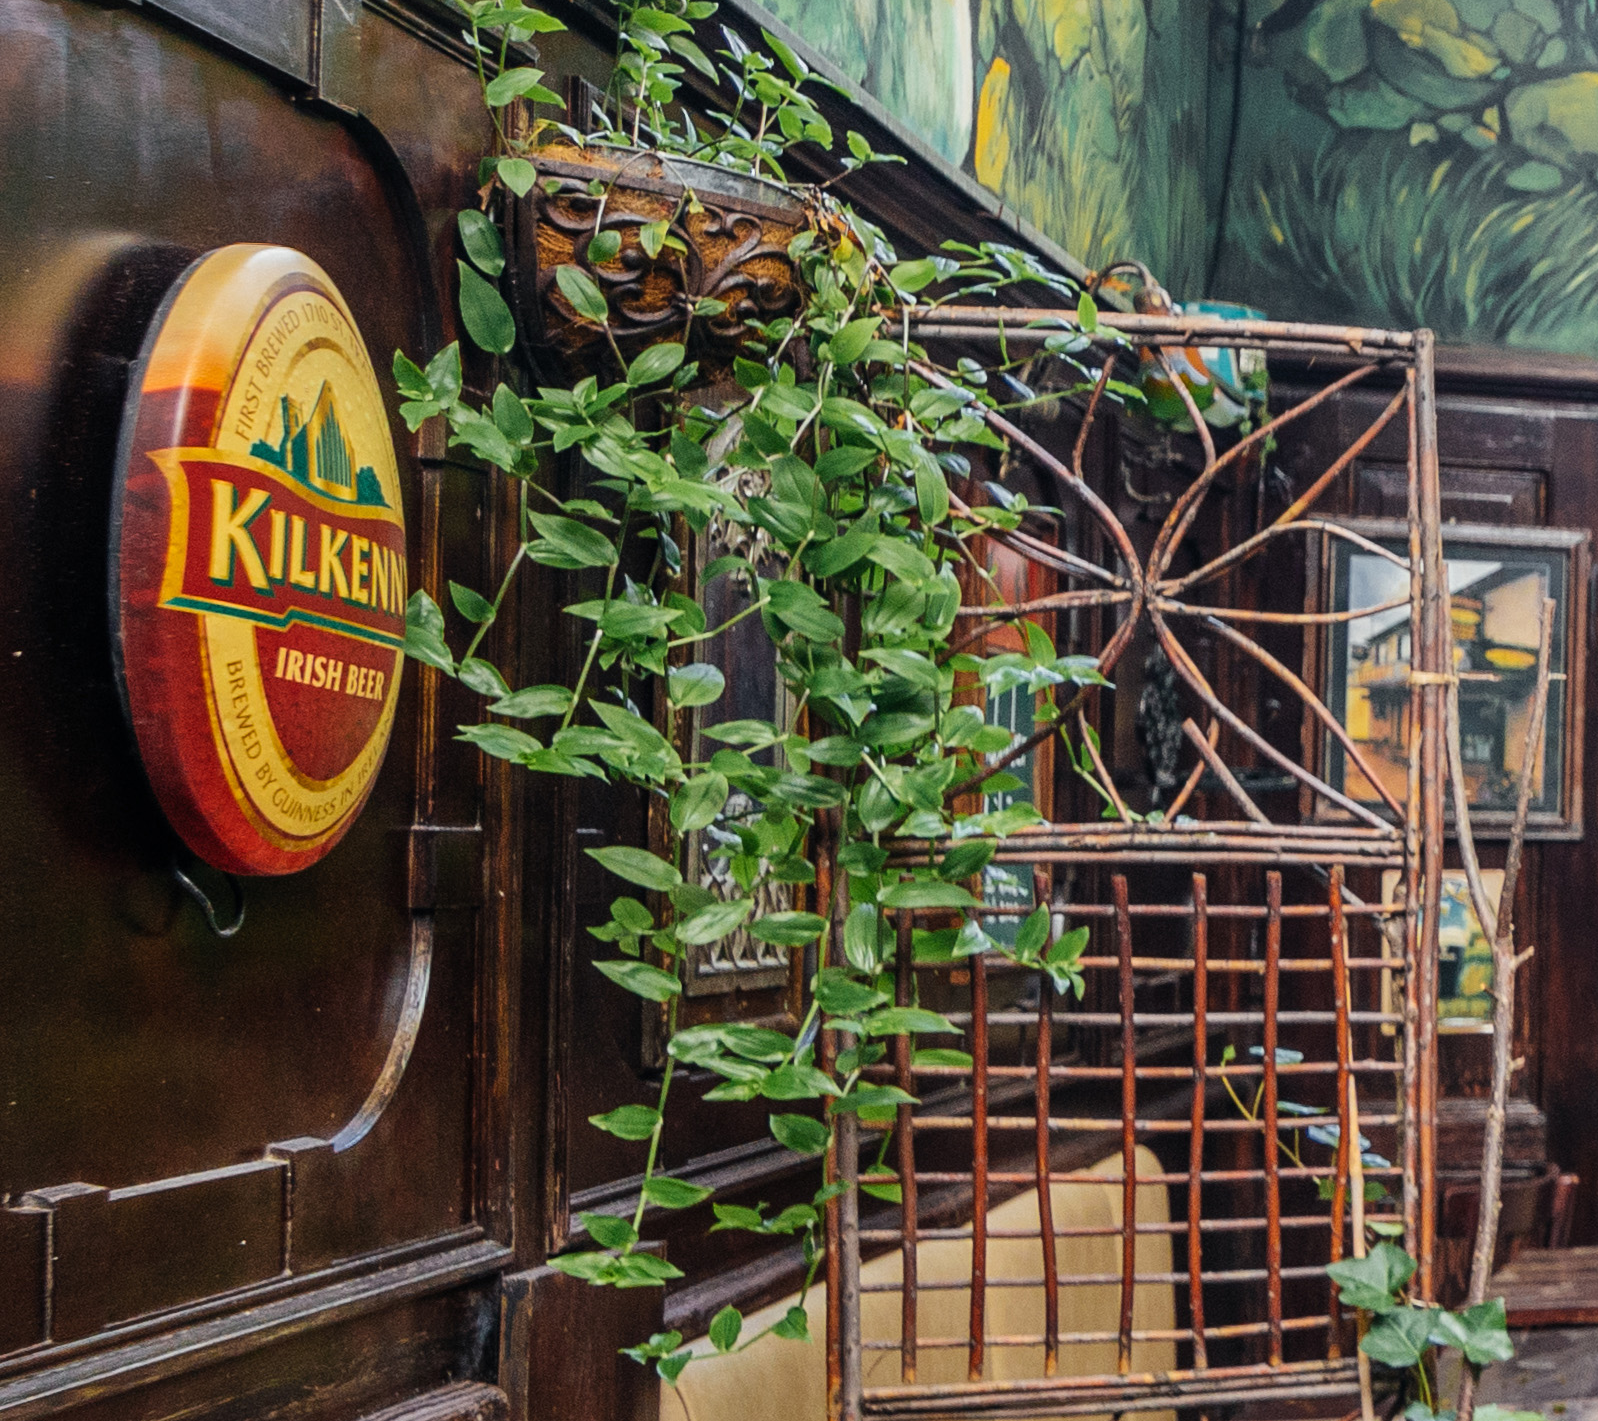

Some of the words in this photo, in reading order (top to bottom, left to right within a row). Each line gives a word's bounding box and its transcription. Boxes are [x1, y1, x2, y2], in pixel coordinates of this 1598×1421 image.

[234, 376, 265, 443] FIRST
[256, 308, 301, 379] BREWED
[303, 302, 329, 325] 1710
[208, 479, 408, 617] KILKENN
[226, 659, 263, 761] BREWED
[255, 761, 278, 790] BY
[271, 787, 337, 824] GUINNESS
[275, 646, 344, 692] IRISH
[345, 664, 386, 702] BEER
